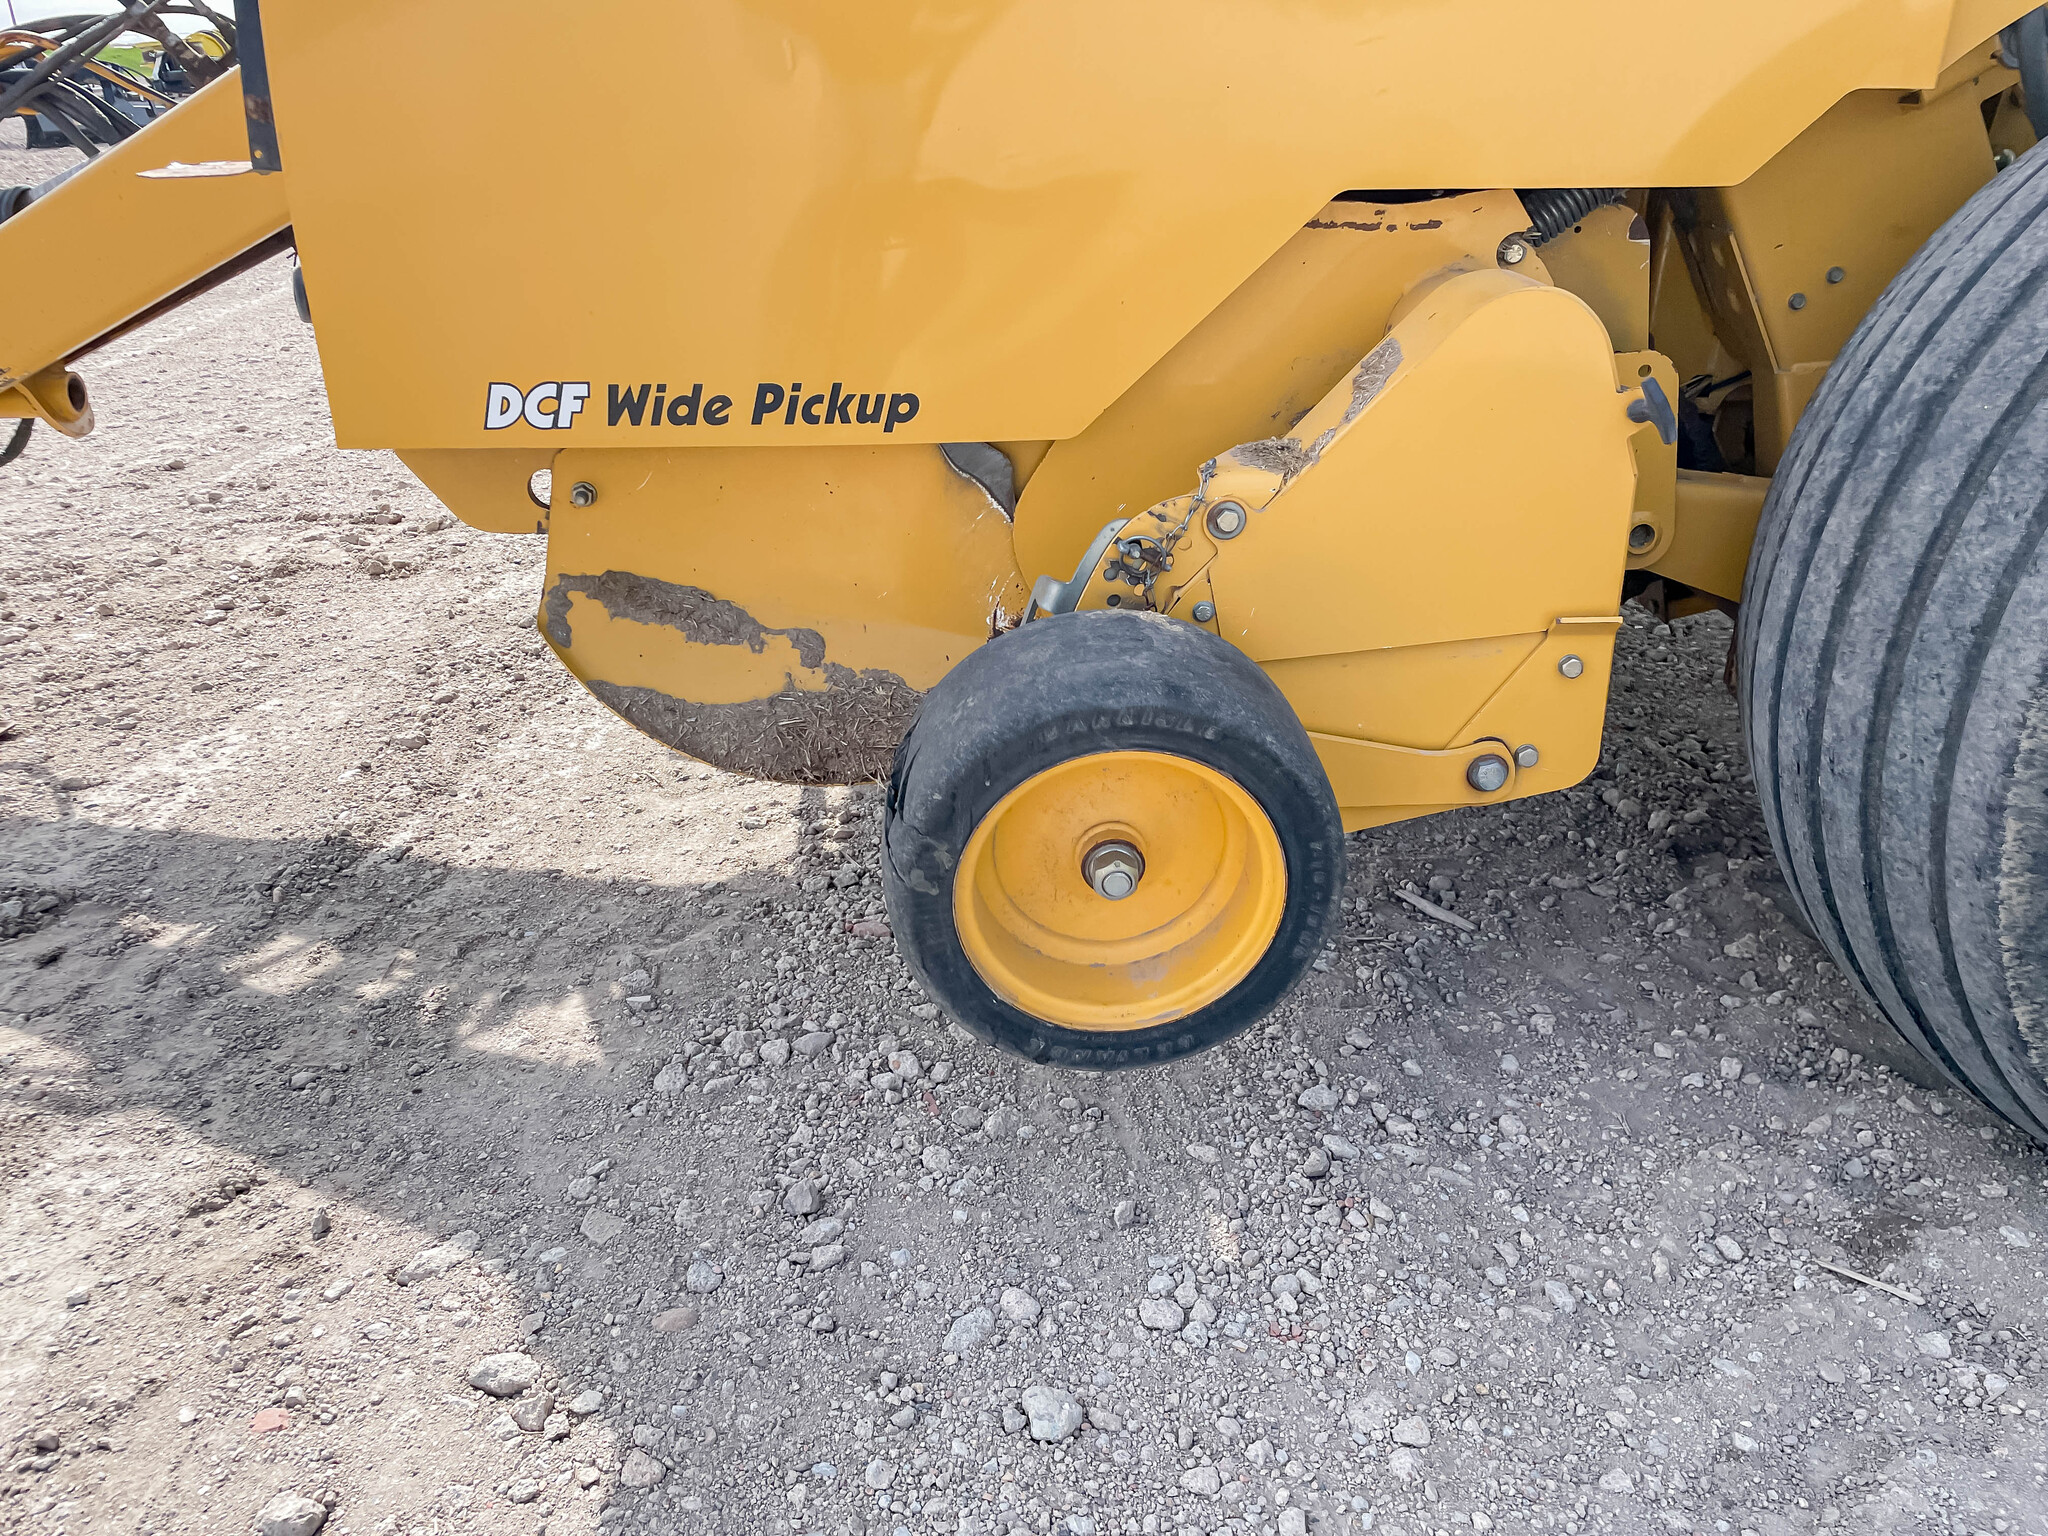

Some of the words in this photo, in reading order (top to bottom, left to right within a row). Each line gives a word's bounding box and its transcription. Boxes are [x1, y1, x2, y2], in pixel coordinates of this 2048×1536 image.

[484, 381, 591, 430] DCF
[607, 383, 733, 426] Wide
[750, 382, 921, 433] Pickup
